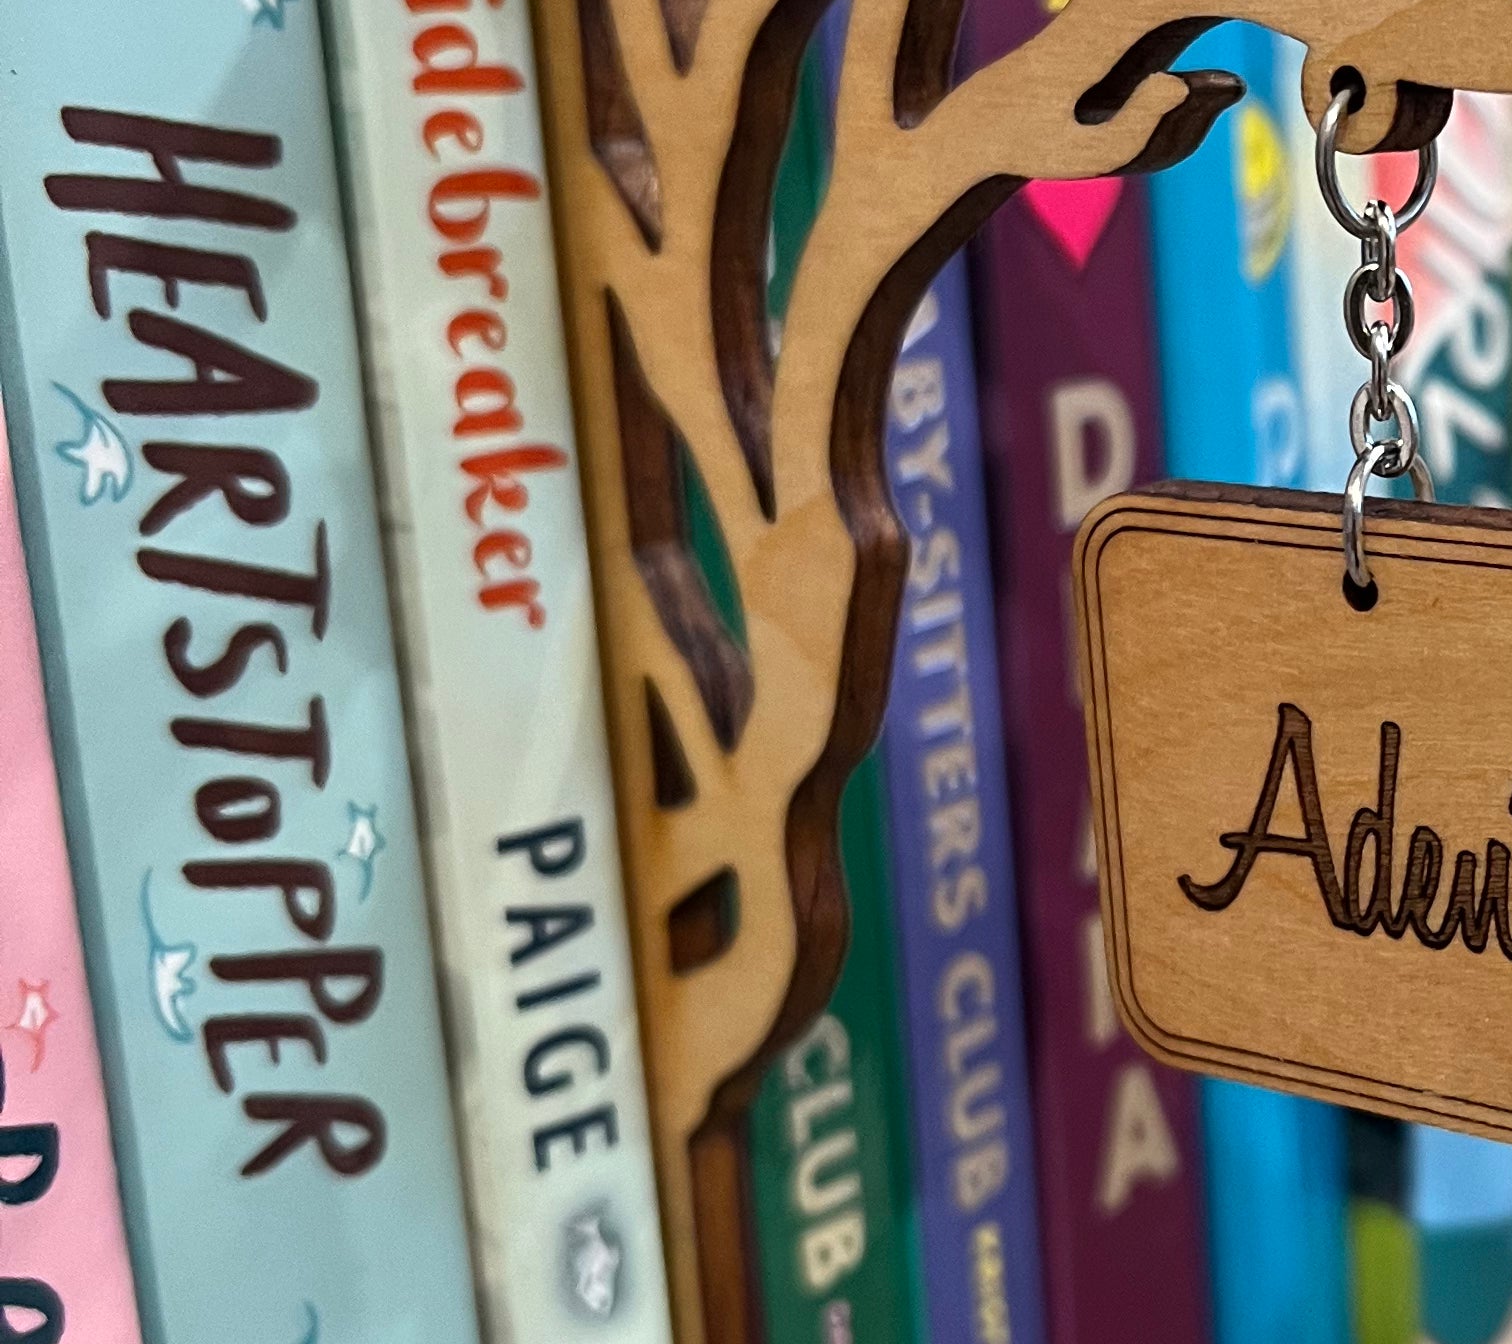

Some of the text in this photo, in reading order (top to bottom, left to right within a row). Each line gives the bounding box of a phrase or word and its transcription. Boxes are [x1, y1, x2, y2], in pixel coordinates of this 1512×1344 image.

[43, 105, 388, 1180] HEARTSTOPPER
[494, 816, 621, 1174] PAIGE
[784, 1012, 867, 1294] CLUB
[936, 950, 1010, 1212] CLUB
